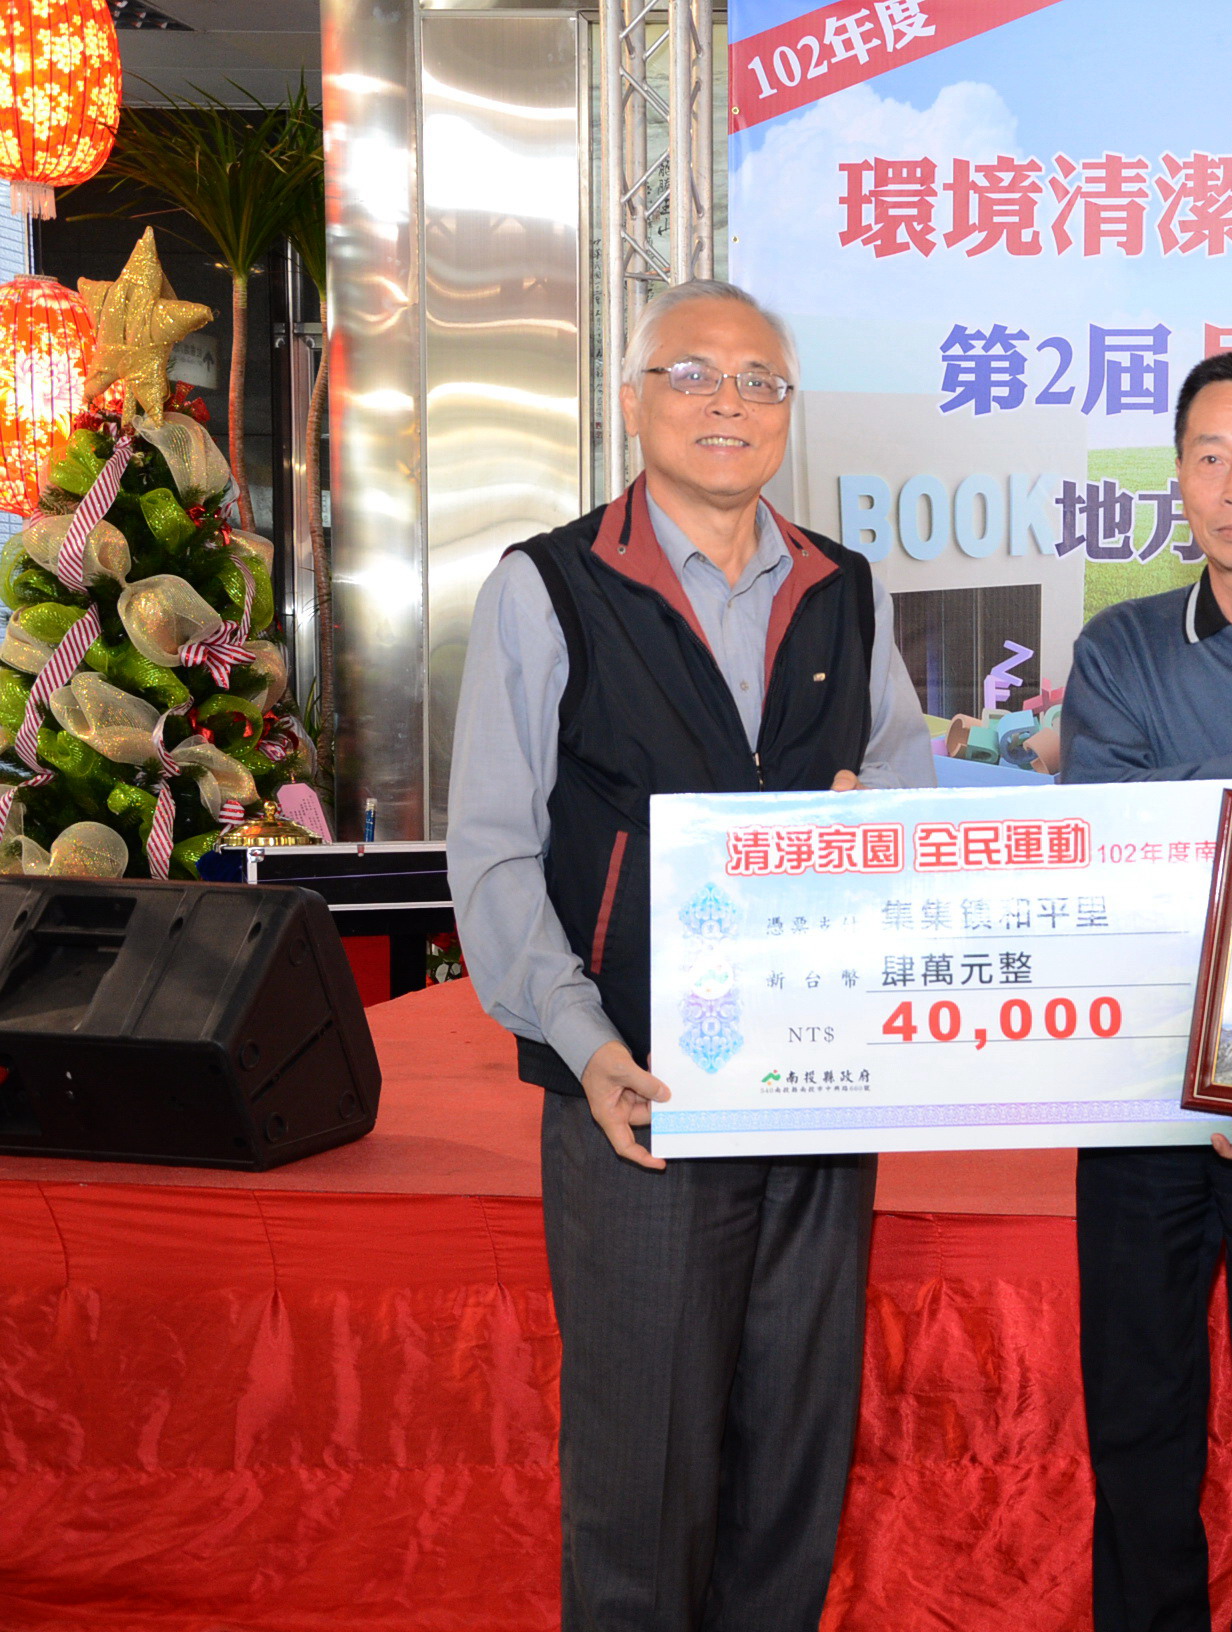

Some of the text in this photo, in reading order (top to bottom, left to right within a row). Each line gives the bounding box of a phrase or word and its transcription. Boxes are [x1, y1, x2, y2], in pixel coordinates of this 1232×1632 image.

[747, 0, 936, 100] 102年度
[938, 322, 1172, 416] 第2屆
[838, 473, 1062, 564] BOOK
[728, 825, 902, 874] 清淨家園
[915, 820, 1089, 870] 全民運動
[766, 950, 1033, 990] 新台幣 肆萬元整
[787, 995, 1123, 1051] NT$ 40,000
[785, 1068, 871, 1085] 南投縣政府
